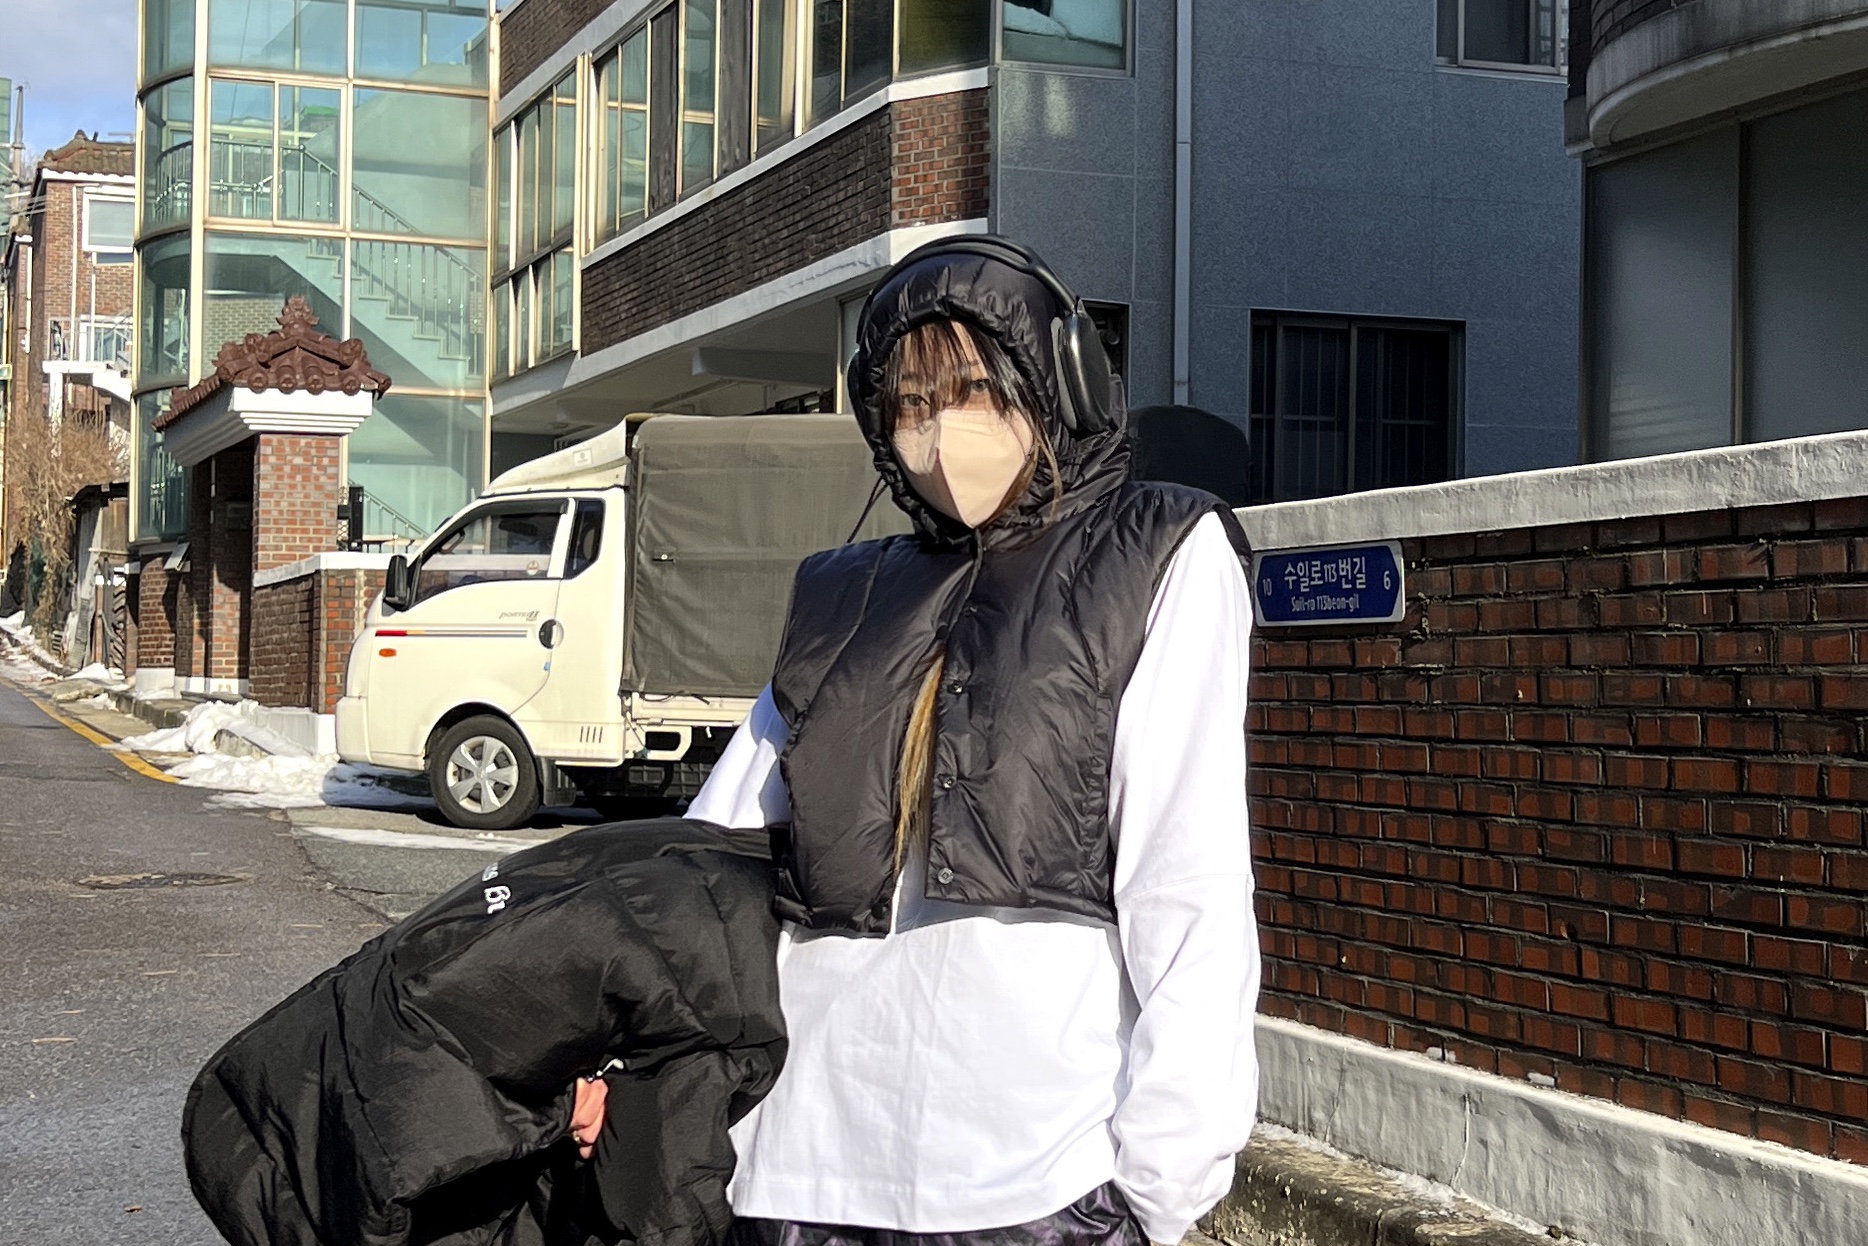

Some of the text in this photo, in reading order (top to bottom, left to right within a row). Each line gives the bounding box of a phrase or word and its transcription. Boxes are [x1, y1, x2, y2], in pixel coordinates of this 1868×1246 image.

[1284, 556, 1366, 592] 수일로113번길
[1383, 570, 1392, 590] 6
[1263, 578, 1272, 596] 10
